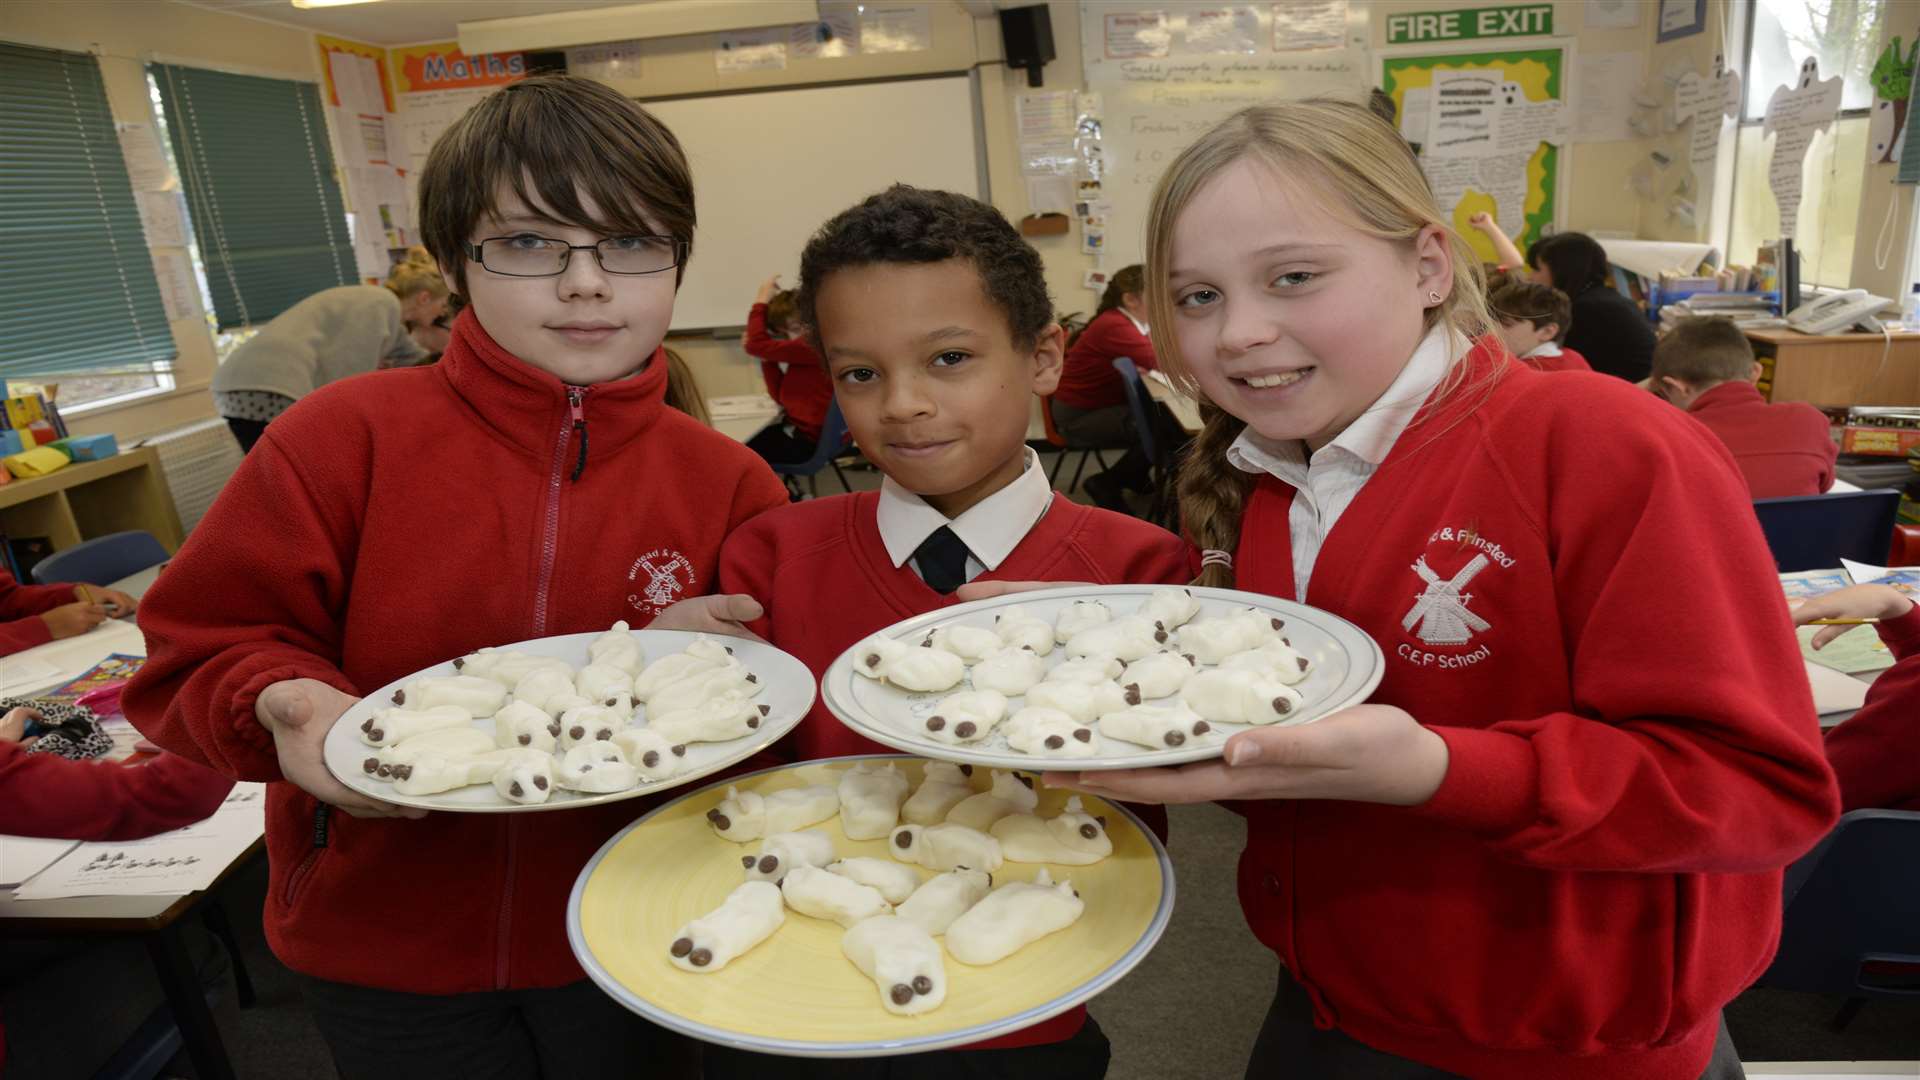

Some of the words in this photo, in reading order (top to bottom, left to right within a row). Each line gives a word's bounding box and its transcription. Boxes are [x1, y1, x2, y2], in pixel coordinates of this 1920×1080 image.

[1389, 13, 1460, 41] FIRE
[1477, 7, 1550, 35] EXIT
[423, 53, 526, 81] Maths
[1440, 527, 1454, 541] &
[662, 548, 669, 557] &
[1438, 644, 1491, 669] School
